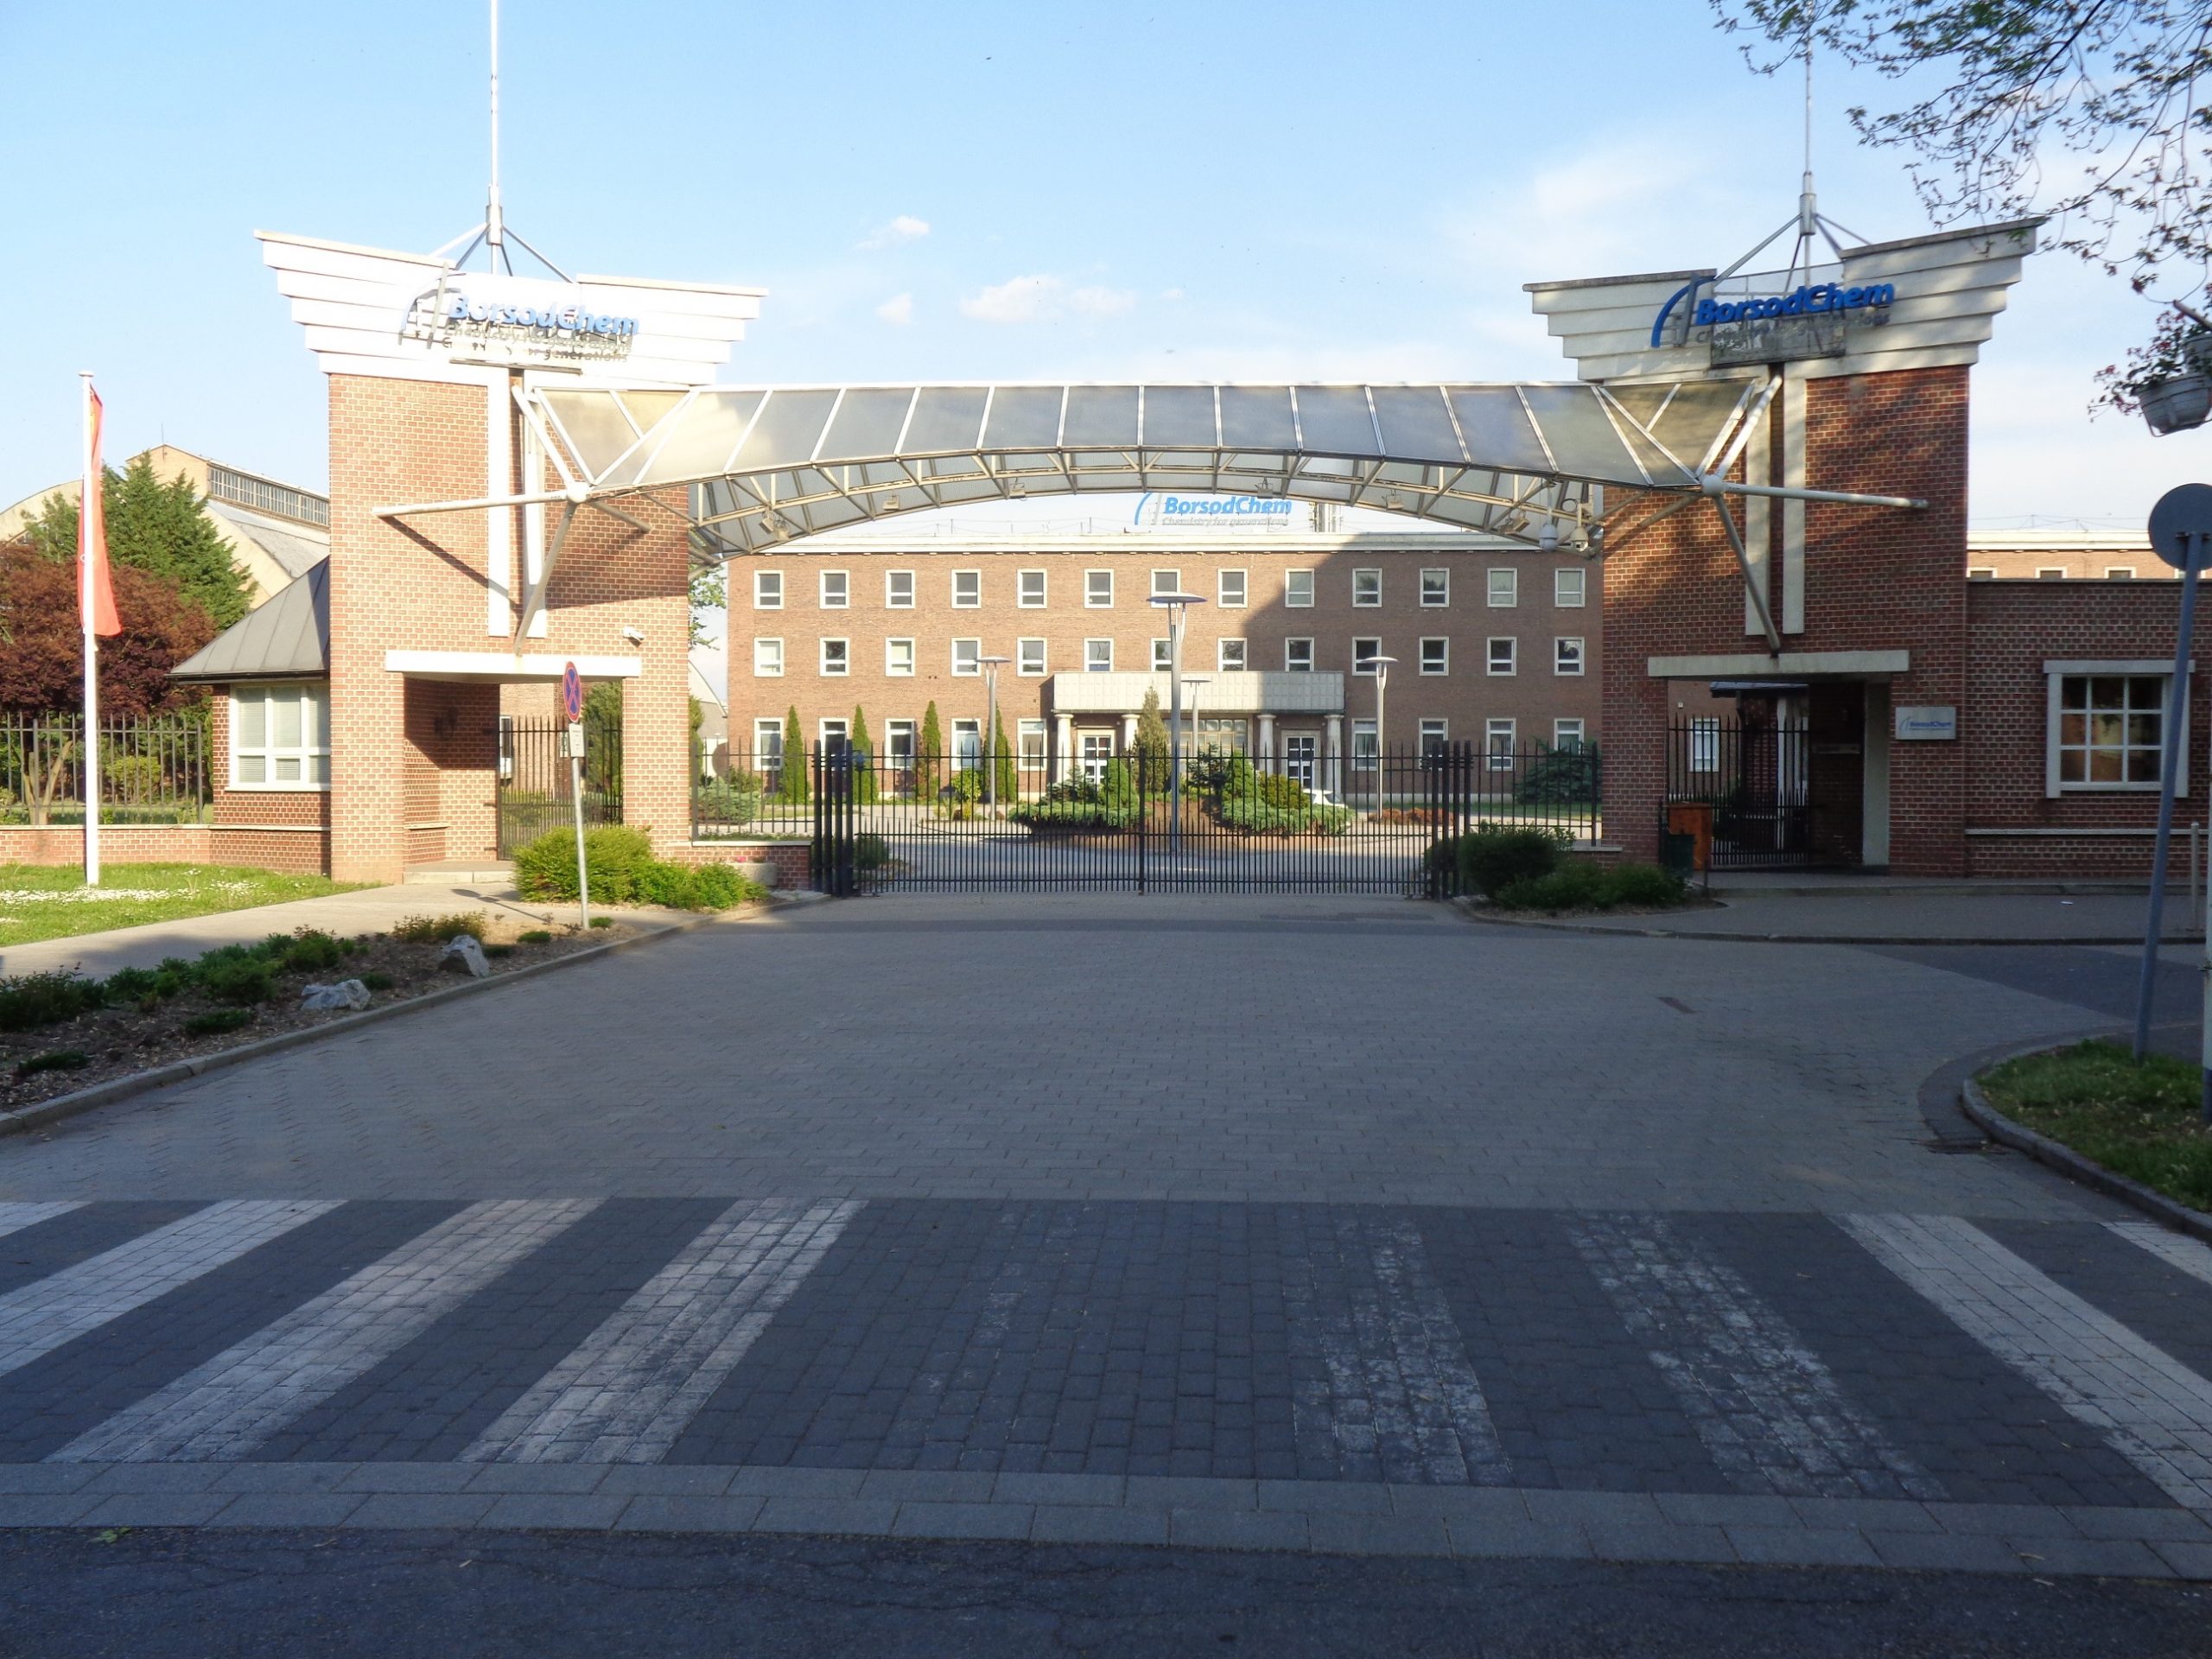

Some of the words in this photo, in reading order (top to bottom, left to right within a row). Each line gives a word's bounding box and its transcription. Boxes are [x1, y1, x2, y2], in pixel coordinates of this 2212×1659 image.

[448, 292, 640, 335] BorsodChem
[1695, 282, 1895, 326] BorsodChem
[1164, 496, 1292, 514] BorsodChem
